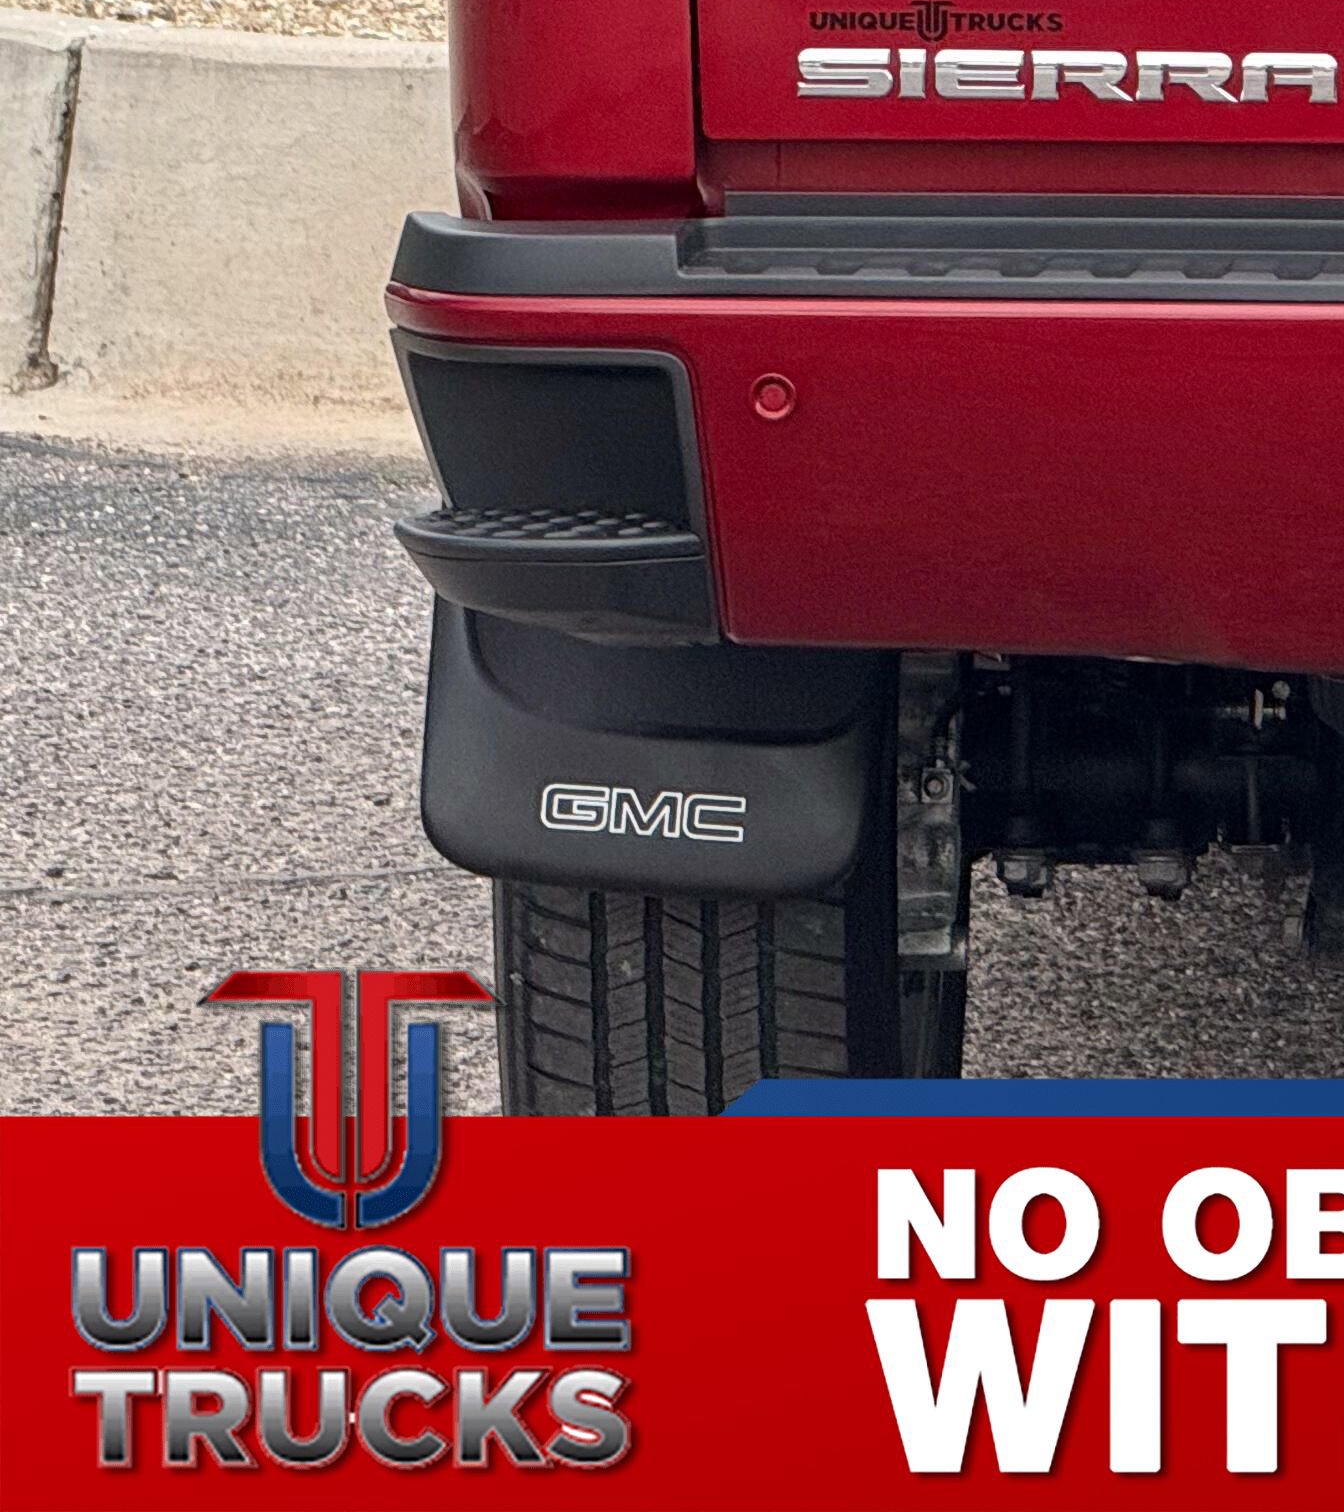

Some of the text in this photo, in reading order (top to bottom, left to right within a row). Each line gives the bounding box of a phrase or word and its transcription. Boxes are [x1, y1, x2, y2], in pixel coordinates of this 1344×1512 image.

[809, 11, 915, 31] UNIQUE
[951, 12, 1064, 32] TRUCKS
[797, 47, 1338, 104] SIERRA
[540, 783, 747, 843] GMC
